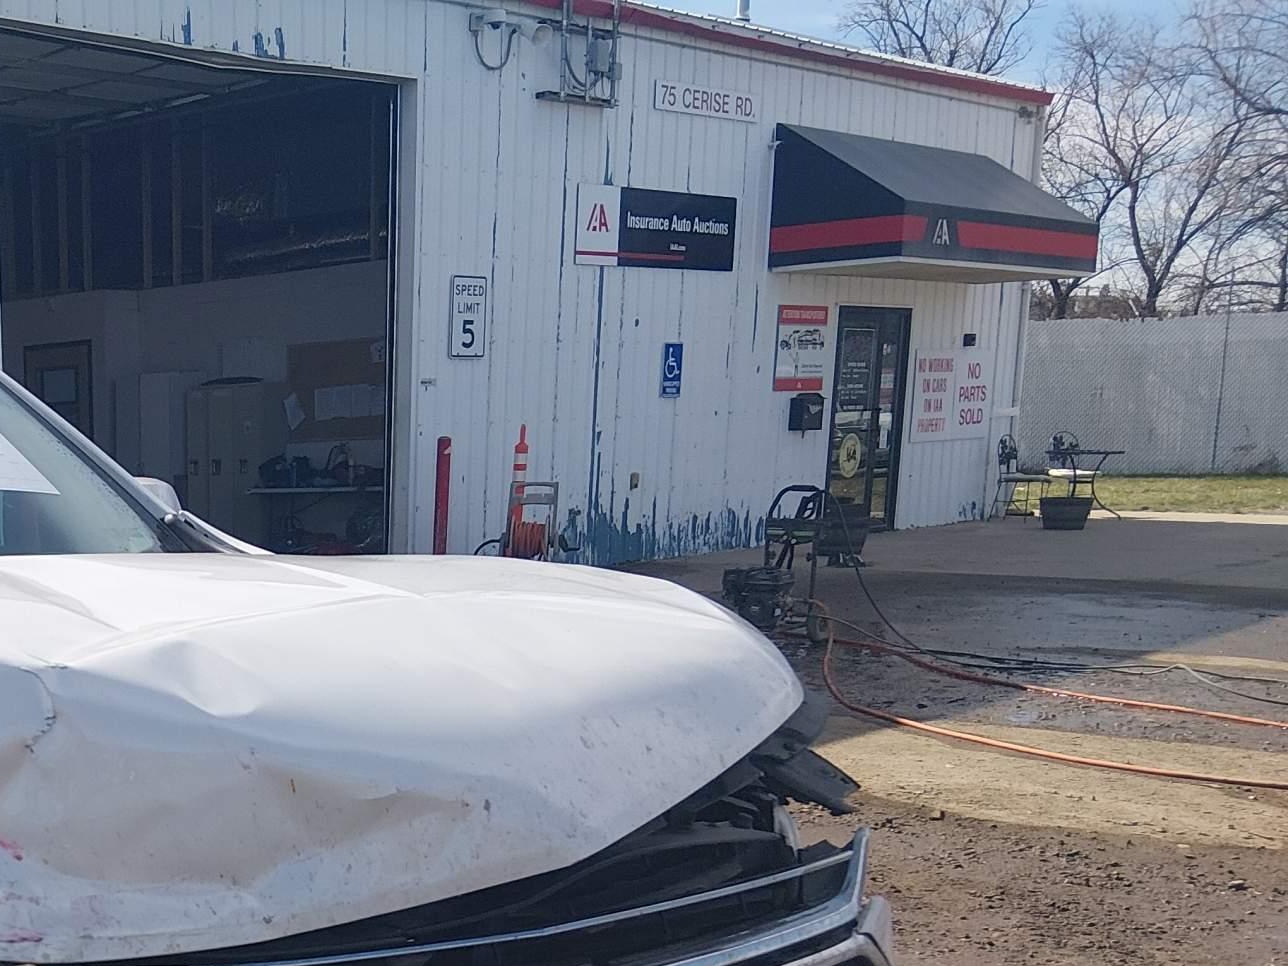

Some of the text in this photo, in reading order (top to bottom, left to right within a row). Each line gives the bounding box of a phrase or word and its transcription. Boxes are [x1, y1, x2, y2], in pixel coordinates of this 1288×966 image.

[661, 84, 756, 118] 75 CERISE RD.
[627, 210, 729, 236] Insurance Auto Auctions
[455, 284, 485, 297] SPEED
[457, 301, 480, 315] LIMIT
[461, 319, 475, 349] 5
[918, 357, 954, 373] NO WORKING
[967, 362, 982, 380] NO
[923, 378, 947, 393] ON CARS
[958, 384, 987, 402] PARTS
[923, 398, 943, 413] ON IAA
[916, 417, 946, 433] PROPERTY
[958, 407, 984, 426] SOLD
